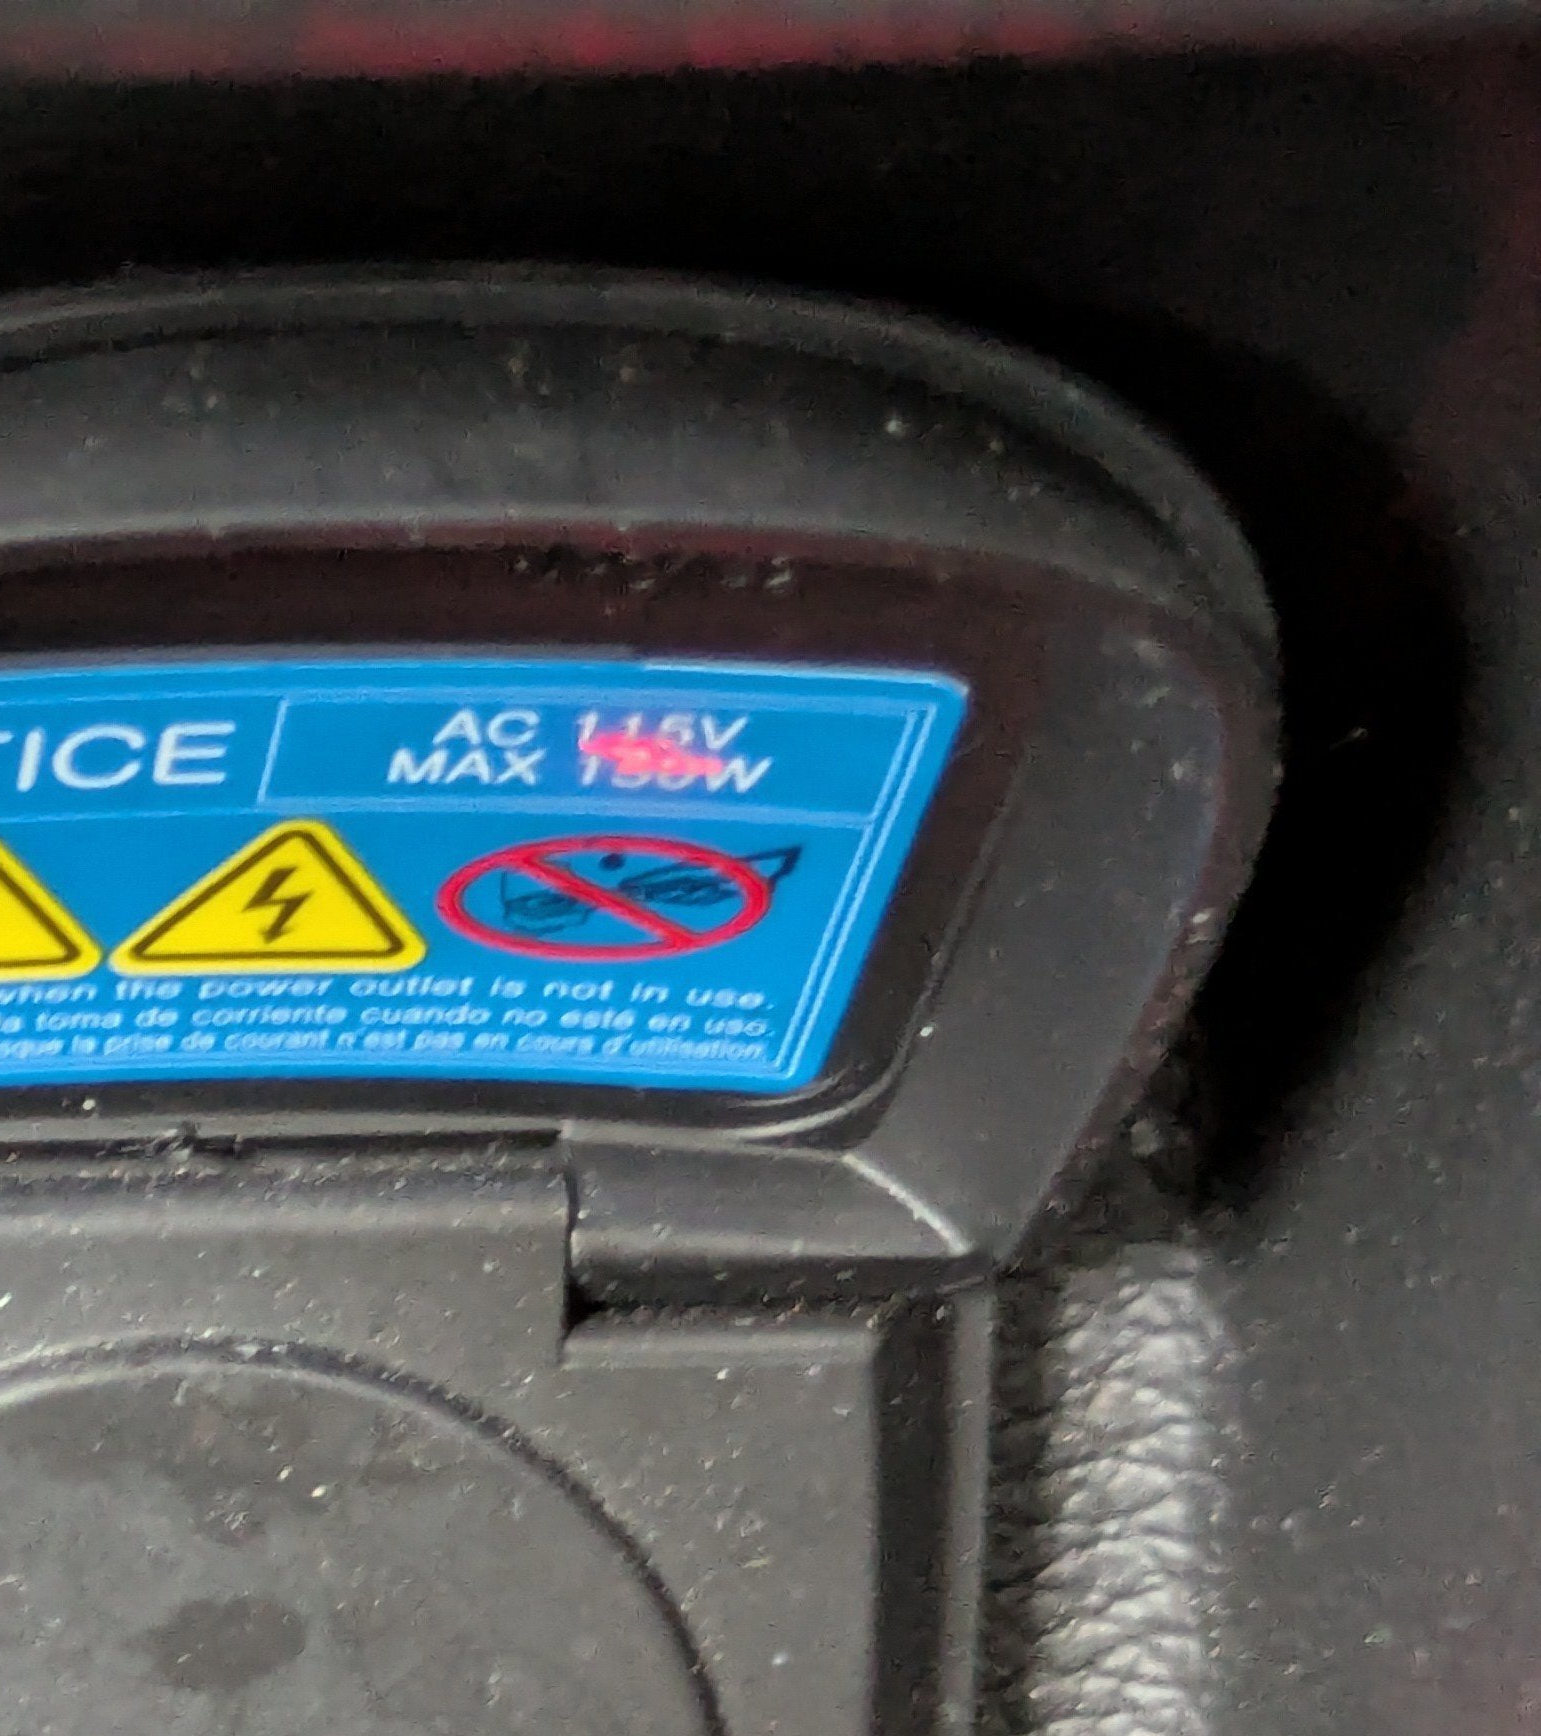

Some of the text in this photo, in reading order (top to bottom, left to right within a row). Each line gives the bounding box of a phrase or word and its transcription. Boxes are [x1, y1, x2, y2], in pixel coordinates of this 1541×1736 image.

[432, 709, 541, 746] AC
[387, 747, 547, 786] MAX
[116, 979, 182, 1001] the
[199, 978, 334, 1000] power
[349, 975, 474, 997] outlet
[490, 976, 527, 998] is
[543, 980, 614, 1001] not
[631, 982, 670, 1003] in
[686, 987, 775, 1011] use.
[35, 1010, 122, 1032] toma
[135, 1006, 179, 1028] de
[192, 1004, 348, 1026] corriente
[360, 1002, 492, 1026] cuando
[502, 1008, 548, 1027] no
[648, 1013, 692, 1033] en
[180, 1031, 217, 1052] de
[473, 1031, 509, 1051] en
